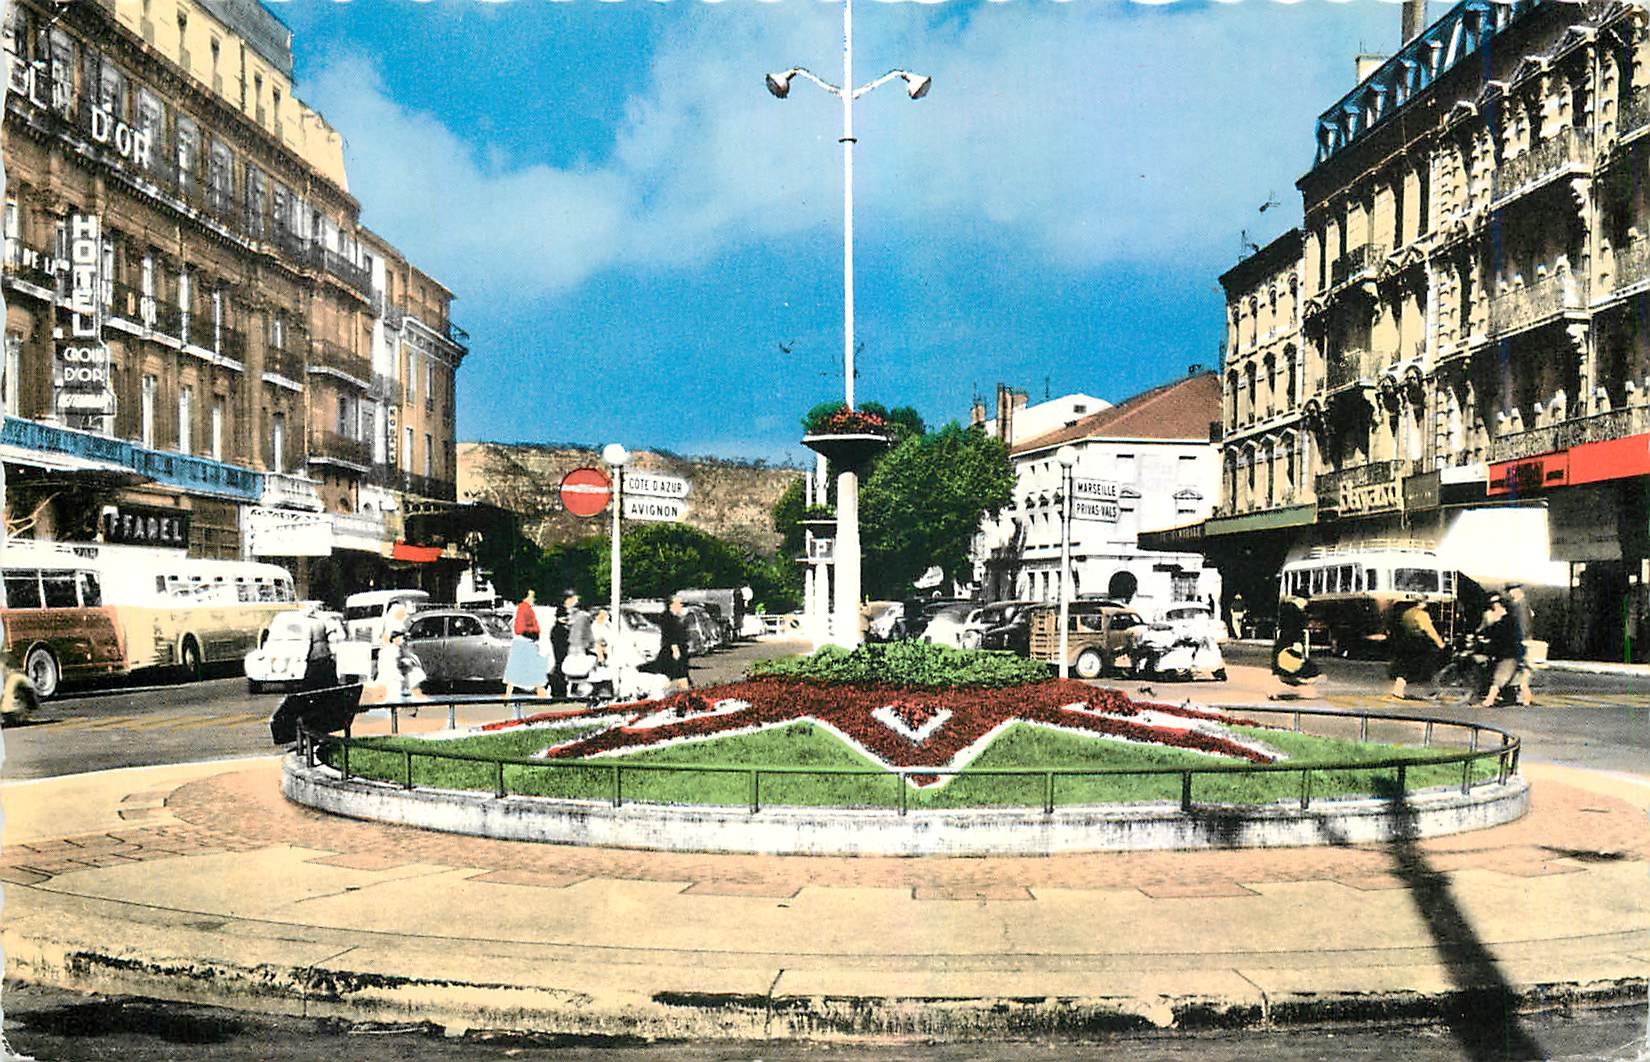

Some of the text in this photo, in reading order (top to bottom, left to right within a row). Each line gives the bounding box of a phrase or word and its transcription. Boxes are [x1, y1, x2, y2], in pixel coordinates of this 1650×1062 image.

[72, 215, 97, 336] HOTEL
[64, 367, 105, 382] D'OR
[1077, 482, 1116, 497] MARSEILLE
[631, 503, 678, 517] AVIGNON
